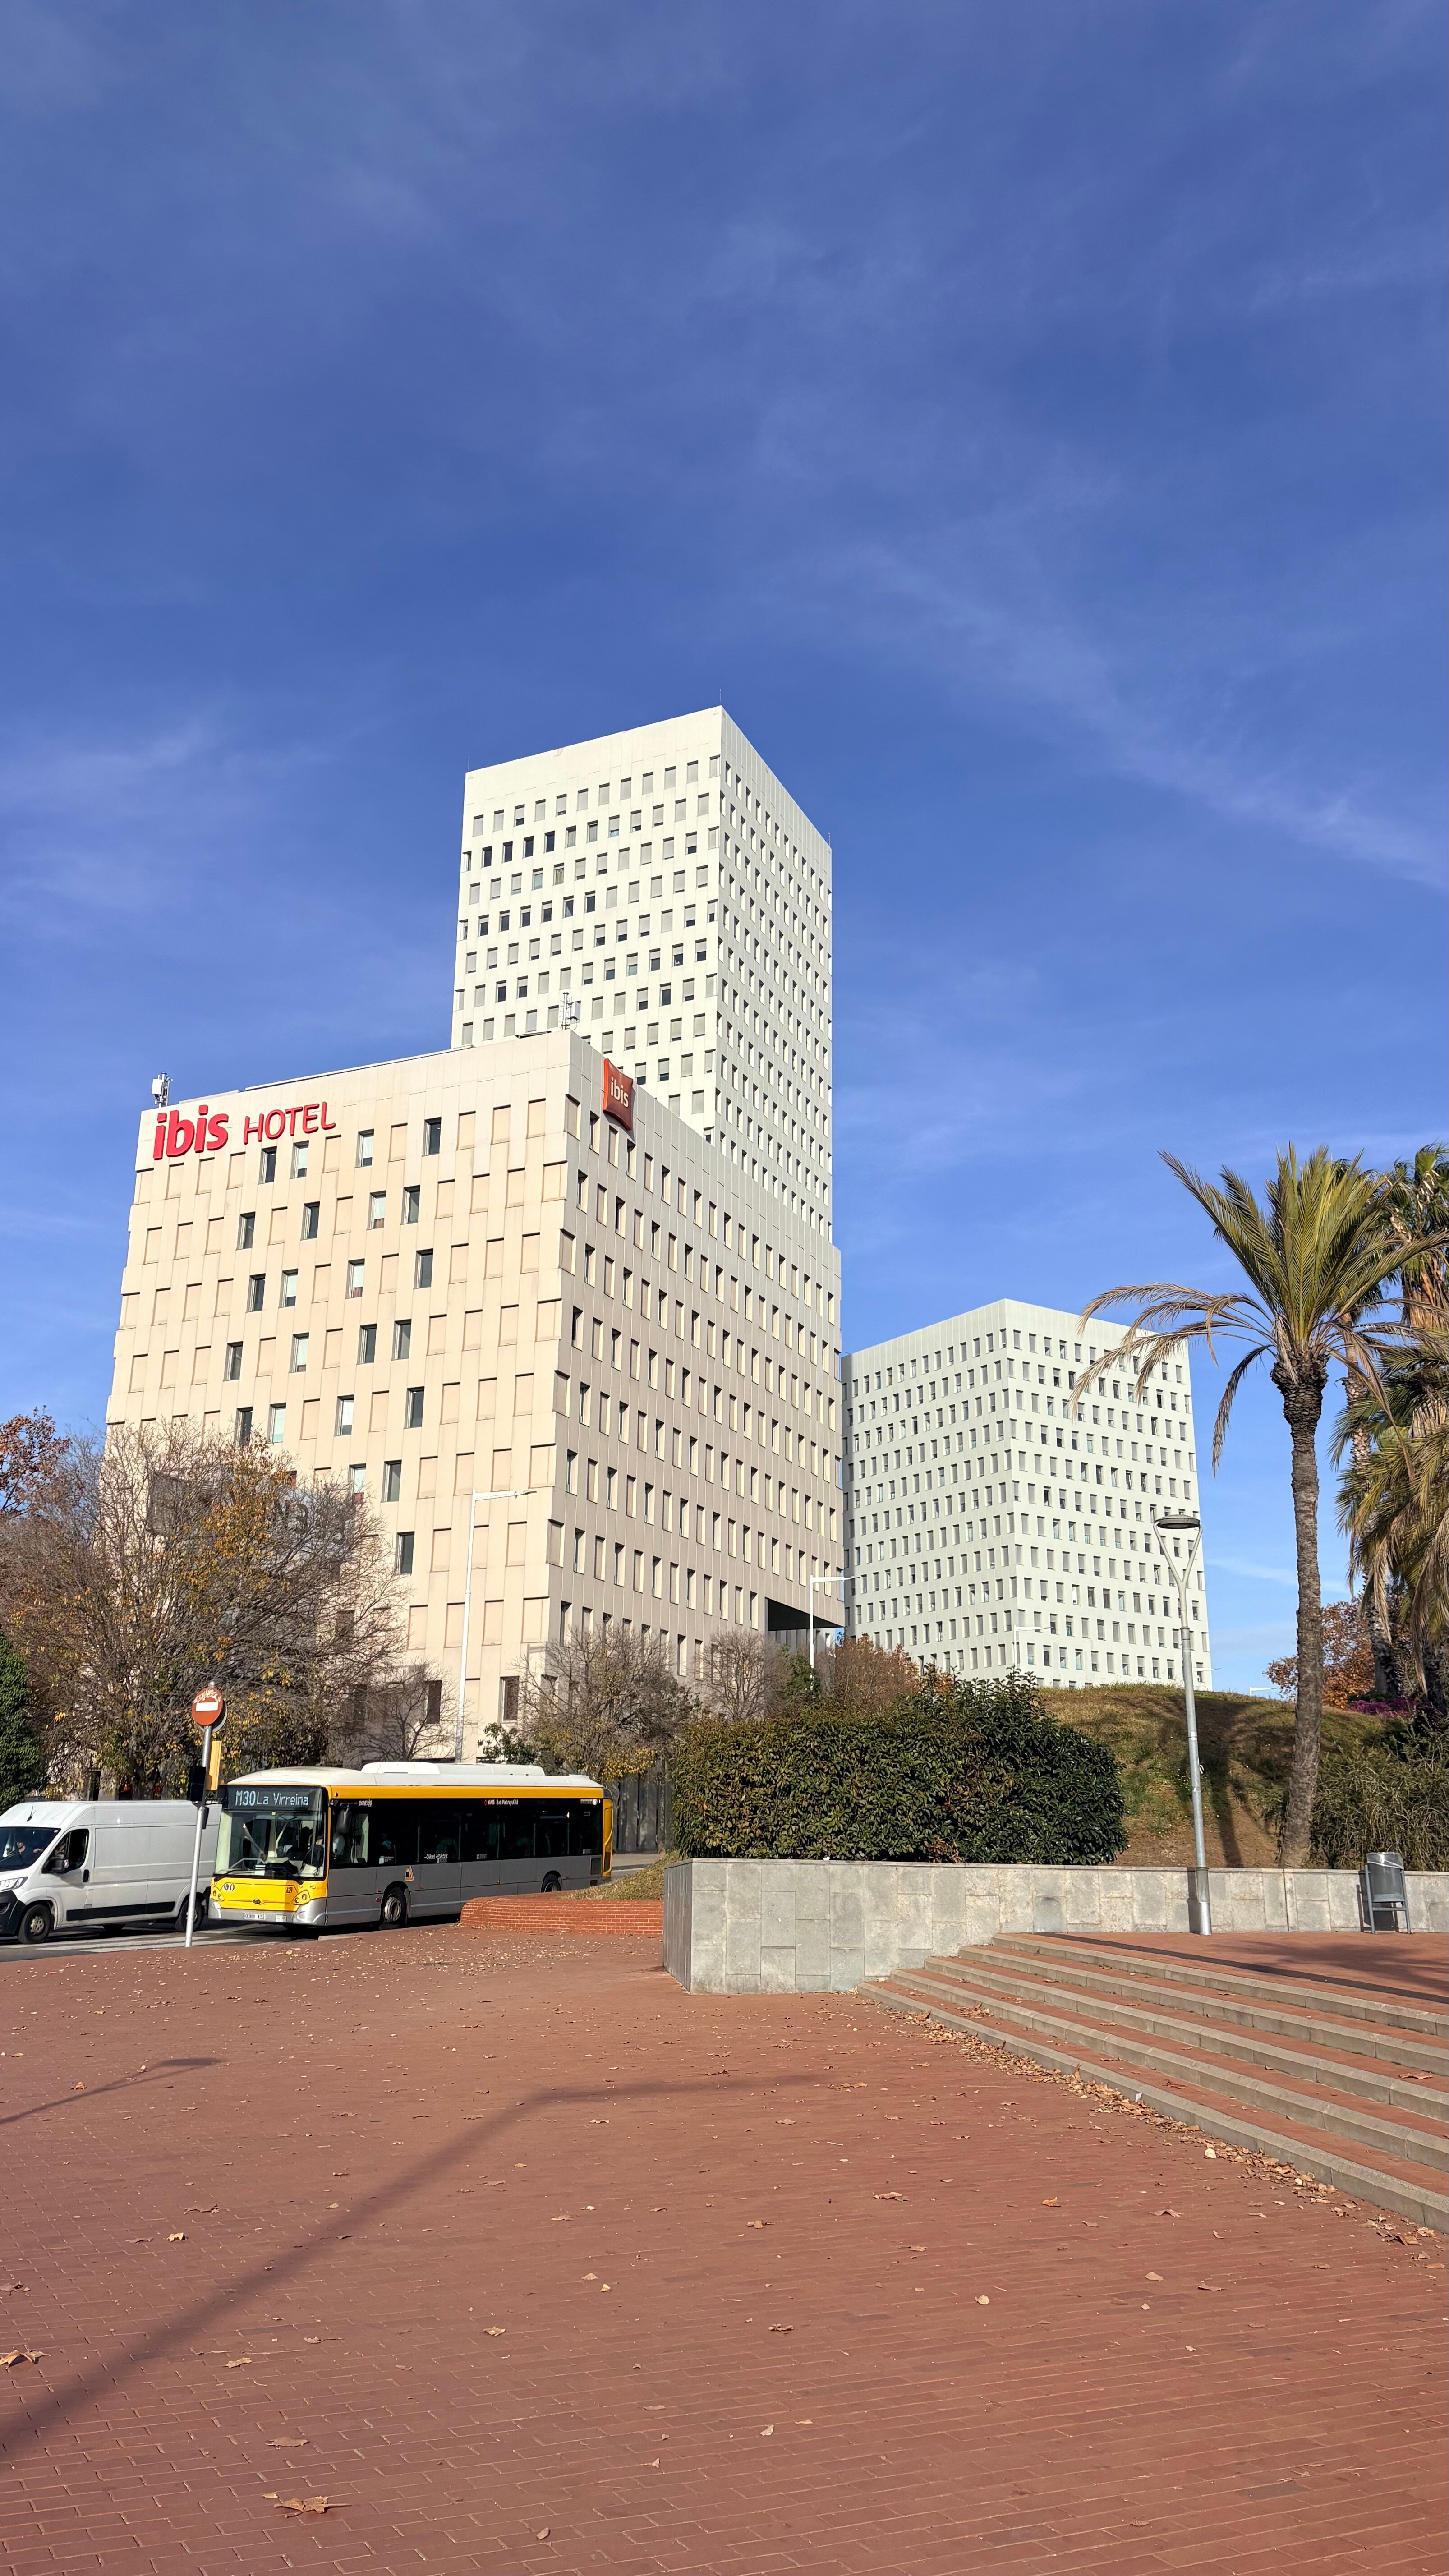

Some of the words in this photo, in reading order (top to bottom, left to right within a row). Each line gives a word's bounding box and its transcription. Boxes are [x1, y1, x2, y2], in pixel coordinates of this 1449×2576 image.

[611, 1076, 629, 1107] ibis
[153, 1104, 229, 1159] ibis
[244, 1101, 336, 1144] HOTEL
[235, 1790, 256, 1806] M30
[256, 1792, 269, 1805] La
[273, 1792, 308, 1806] Virreina
